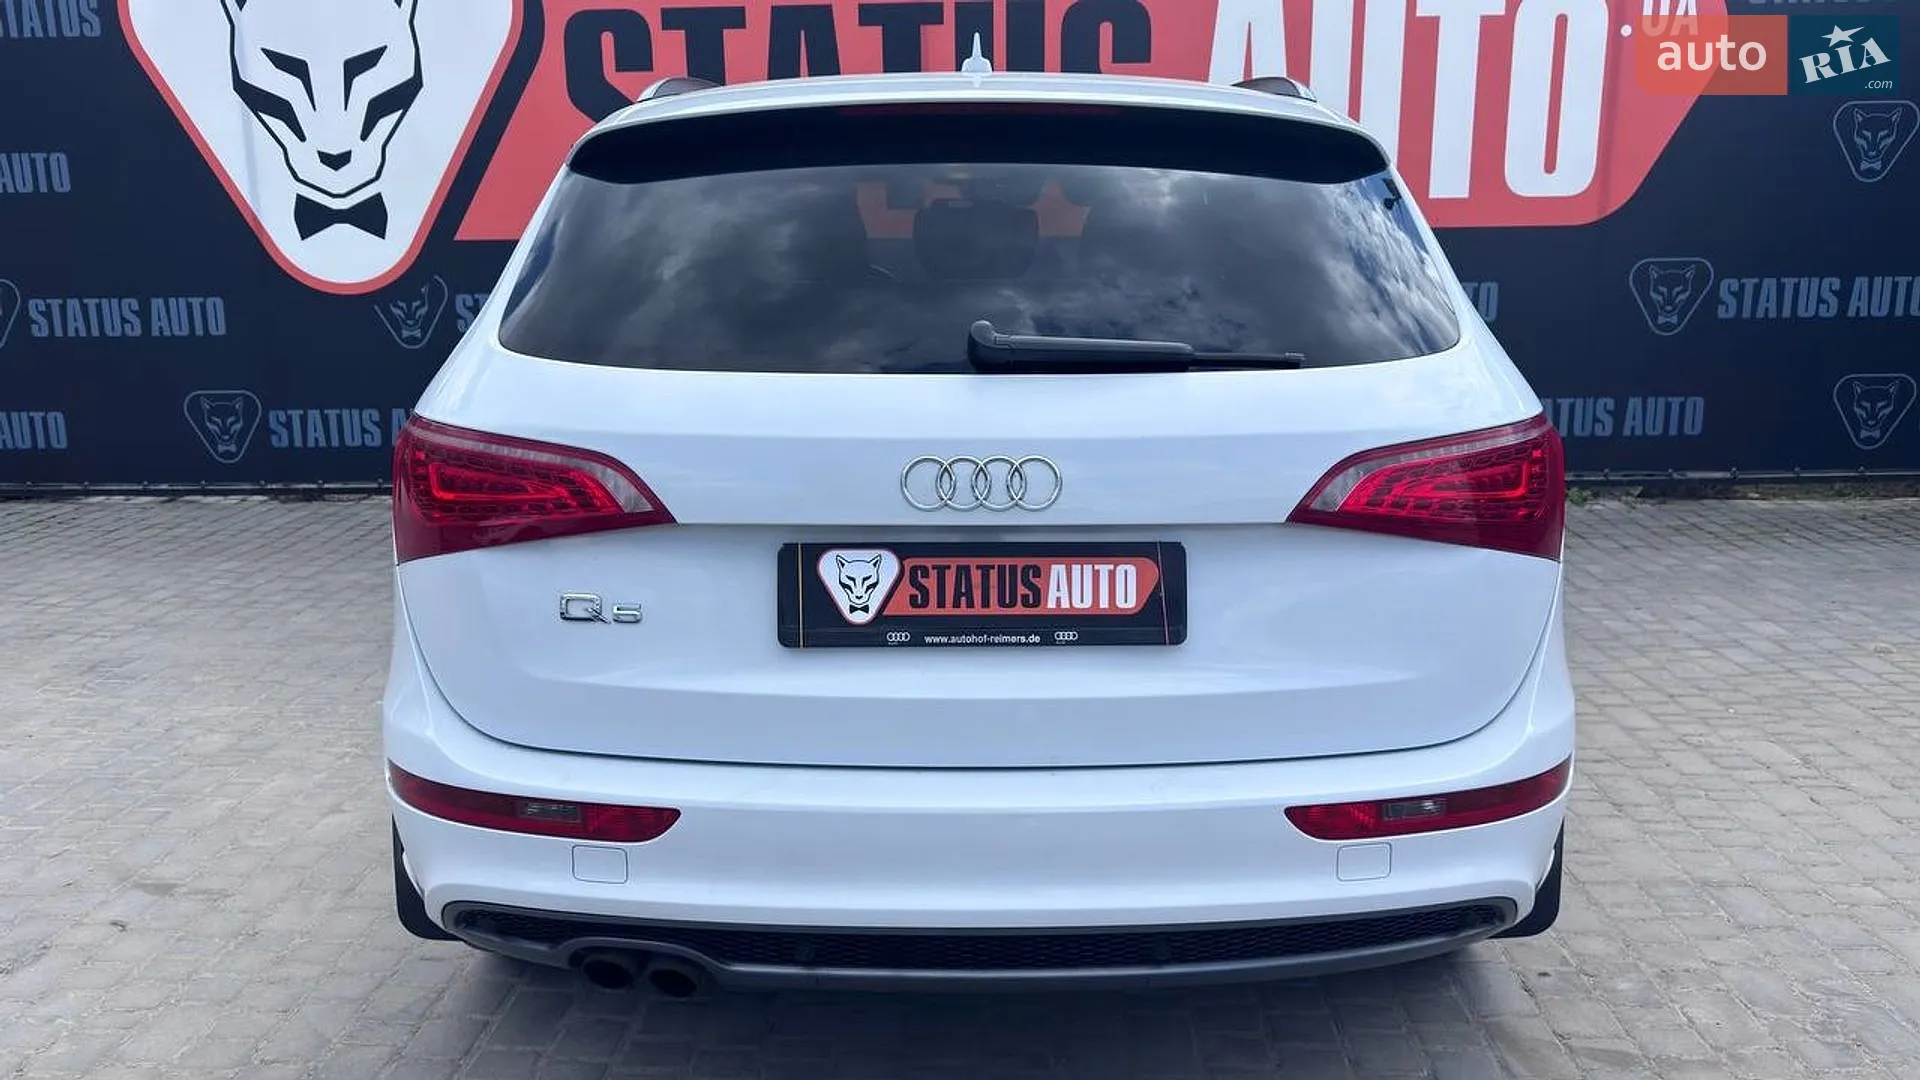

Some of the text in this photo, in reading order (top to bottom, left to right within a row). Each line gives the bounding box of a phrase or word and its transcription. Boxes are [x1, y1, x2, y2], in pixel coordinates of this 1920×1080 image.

[0, 0, 101, 38] TATUS
[28, 297, 227, 337] STATUS AUTO
[1717, 277, 1840, 319] STATUS
[268, 408, 382, 448] STATUS
[1623, 396, 1705, 436] AUTO
[560, 593, 643, 624] Q5
[924, 631, 1041, 644] www.autohof-reimers.de
